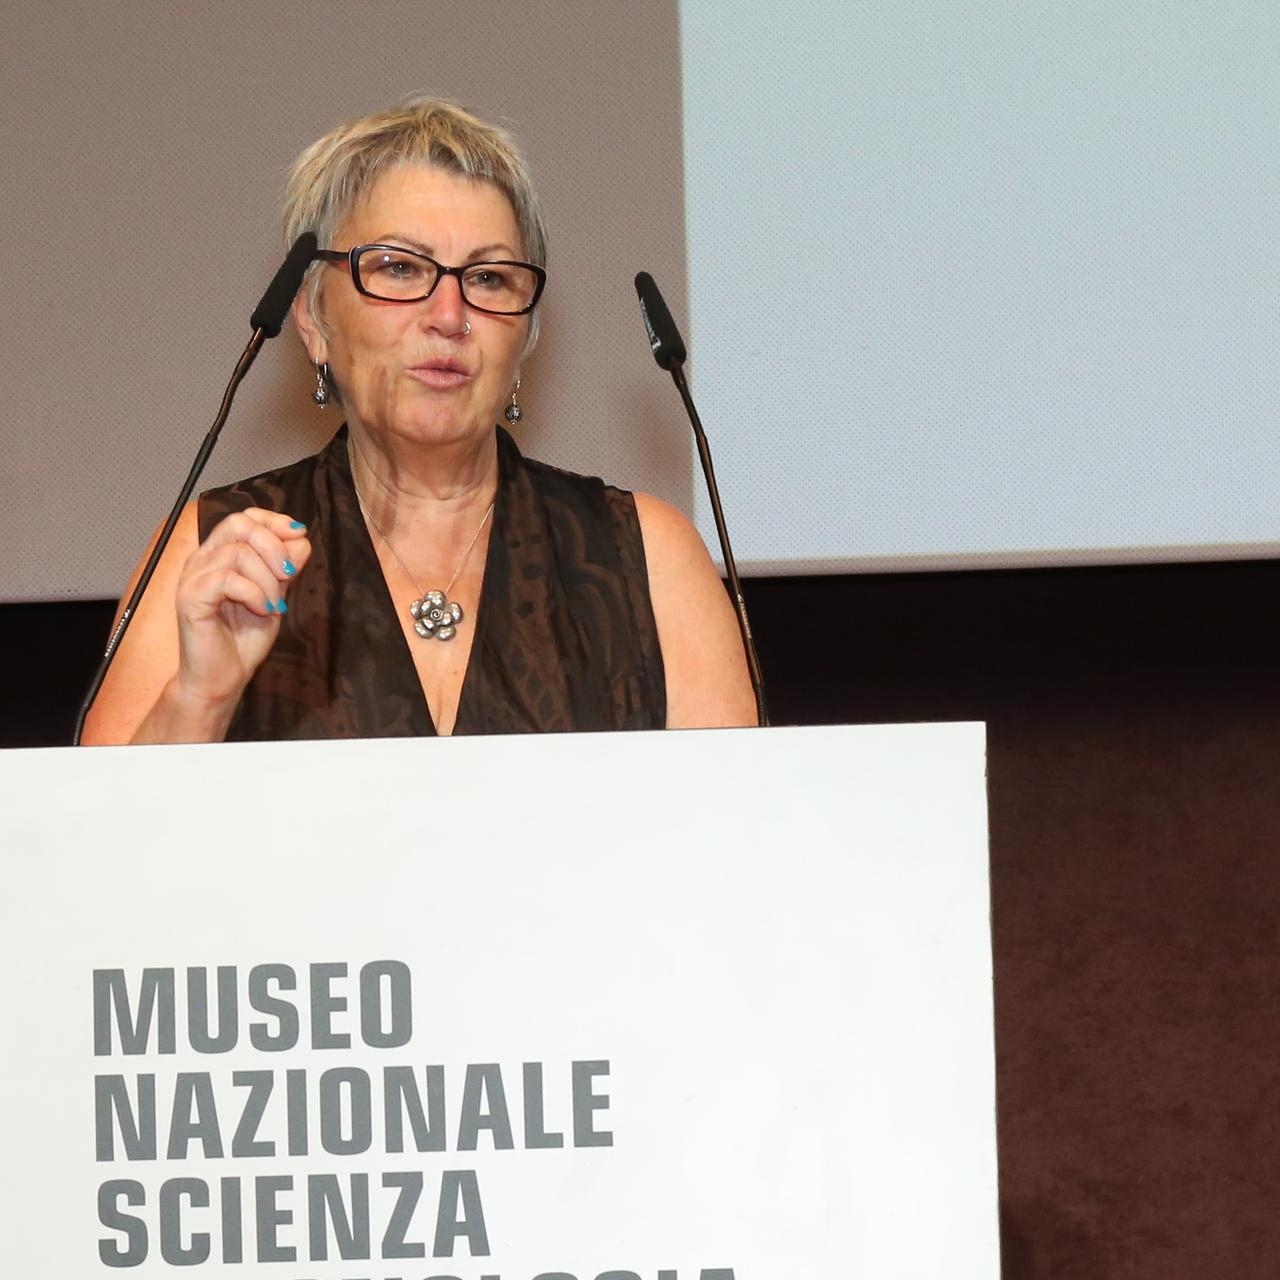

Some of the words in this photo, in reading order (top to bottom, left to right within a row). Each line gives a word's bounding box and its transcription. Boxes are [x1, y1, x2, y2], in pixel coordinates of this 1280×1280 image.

[92, 960, 413, 1056] MUSEO
[94, 1059, 614, 1162] NAZIONALE
[97, 1169, 491, 1268] SCIENZA
